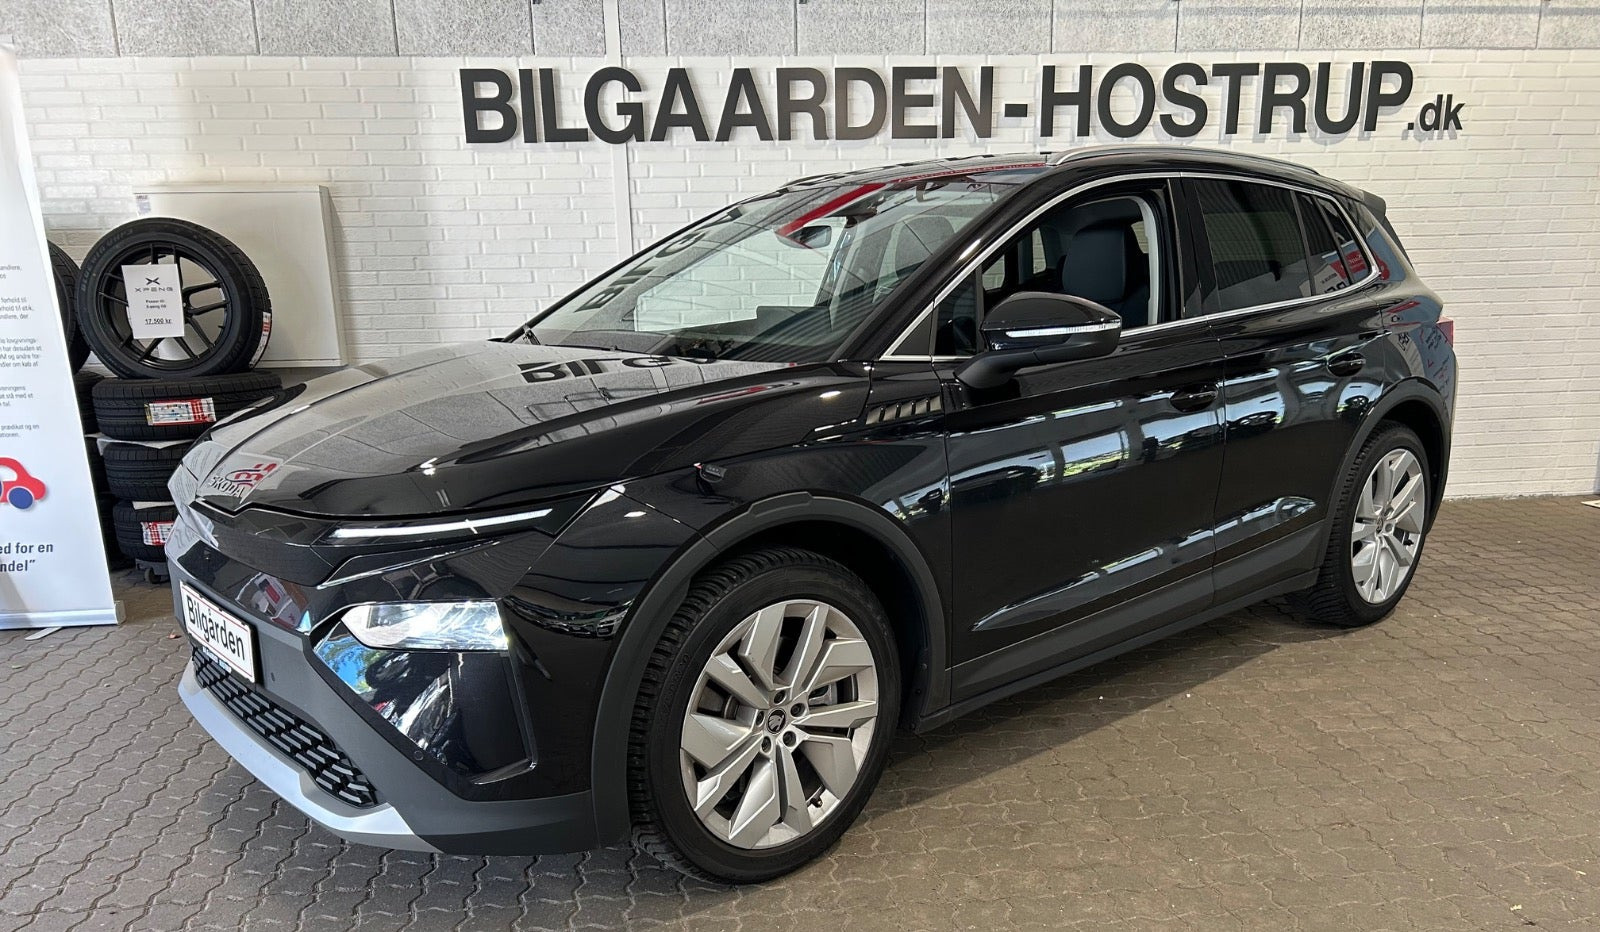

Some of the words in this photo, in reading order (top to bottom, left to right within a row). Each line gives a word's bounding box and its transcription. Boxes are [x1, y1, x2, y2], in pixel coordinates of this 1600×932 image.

[15, 542, 34, 554] for
[38, 544, 54, 553] en
[186, 595, 245, 661] Bilgården
